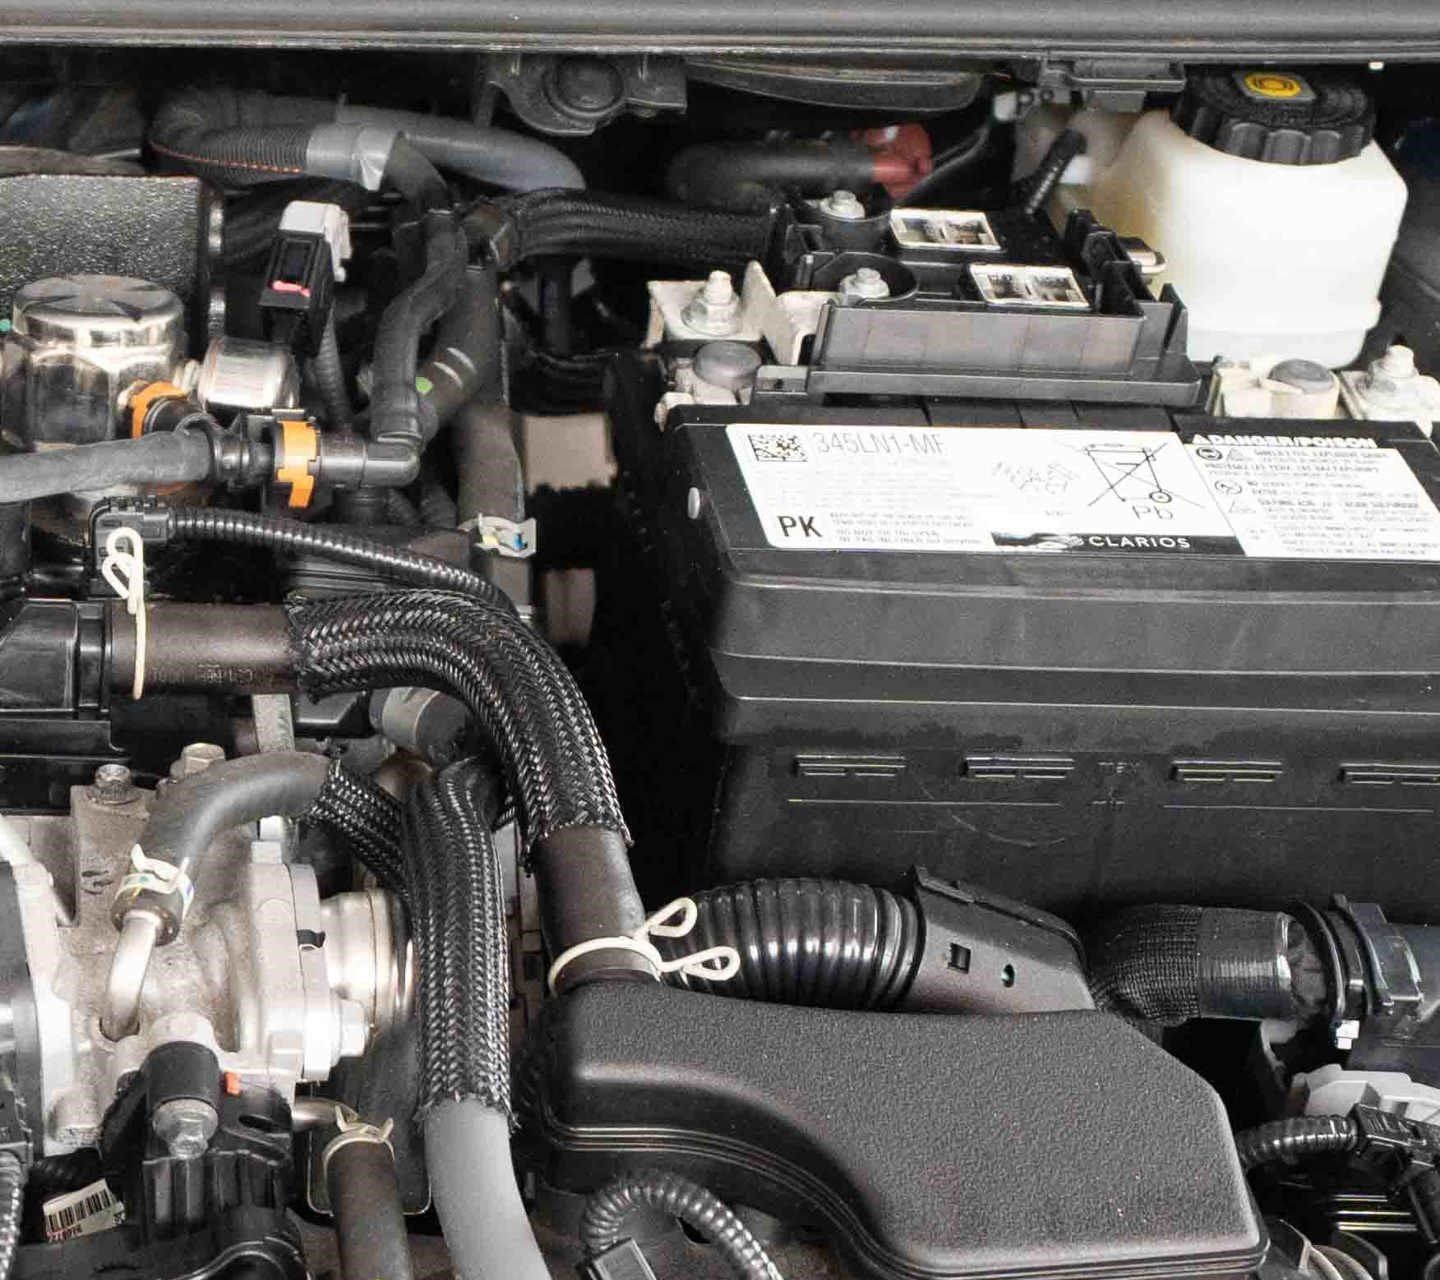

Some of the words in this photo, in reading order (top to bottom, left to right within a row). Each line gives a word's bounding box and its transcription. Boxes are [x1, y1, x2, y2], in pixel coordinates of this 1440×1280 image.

[812, 432, 944, 455] 345LN1-MF
[1132, 505, 1174, 520] Pb
[777, 515, 823, 538] PK
[1088, 534, 1193, 549] CLARIOS
